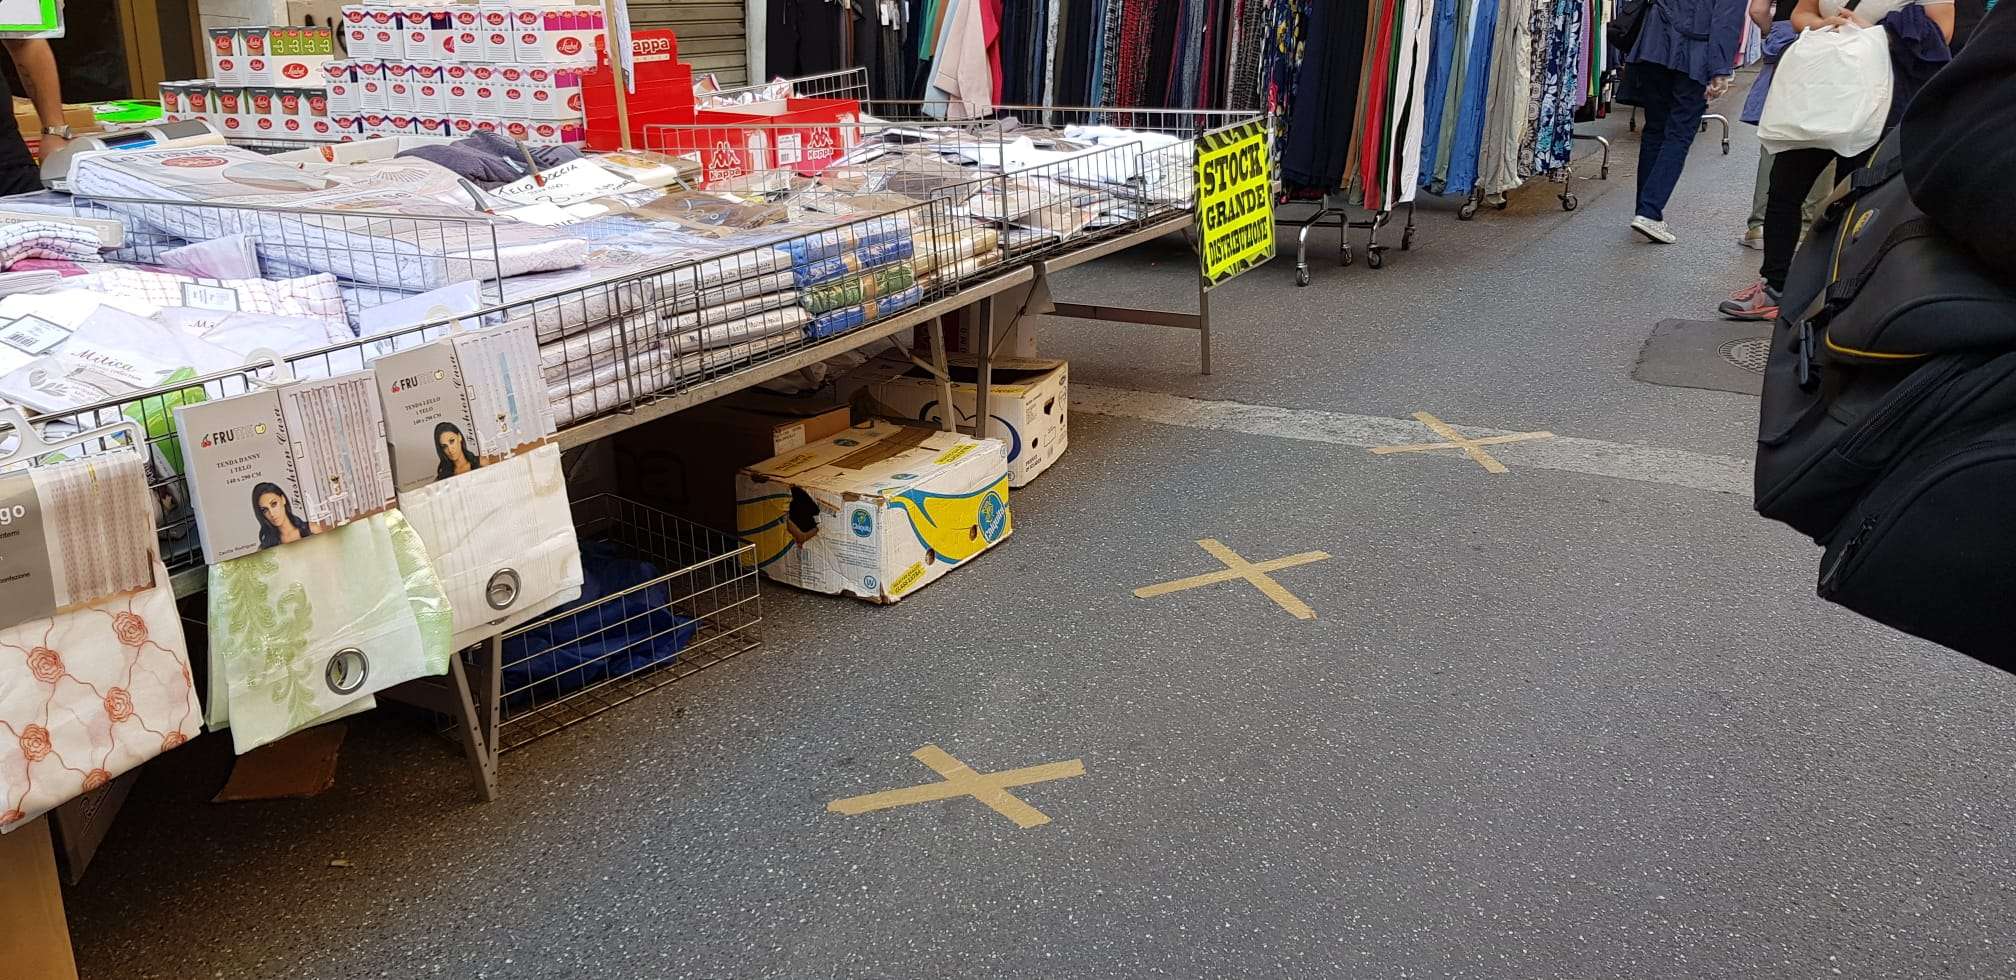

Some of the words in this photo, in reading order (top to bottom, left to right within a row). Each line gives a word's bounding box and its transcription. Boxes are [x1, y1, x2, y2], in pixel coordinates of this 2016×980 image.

[632, 38, 670, 54] appa
[709, 167, 741, 181] Kappa
[1203, 142, 1263, 198] STOCK
[1206, 184, 1266, 232] GRANDE
[1208, 218, 1268, 268] DISTRIBUZIONE
